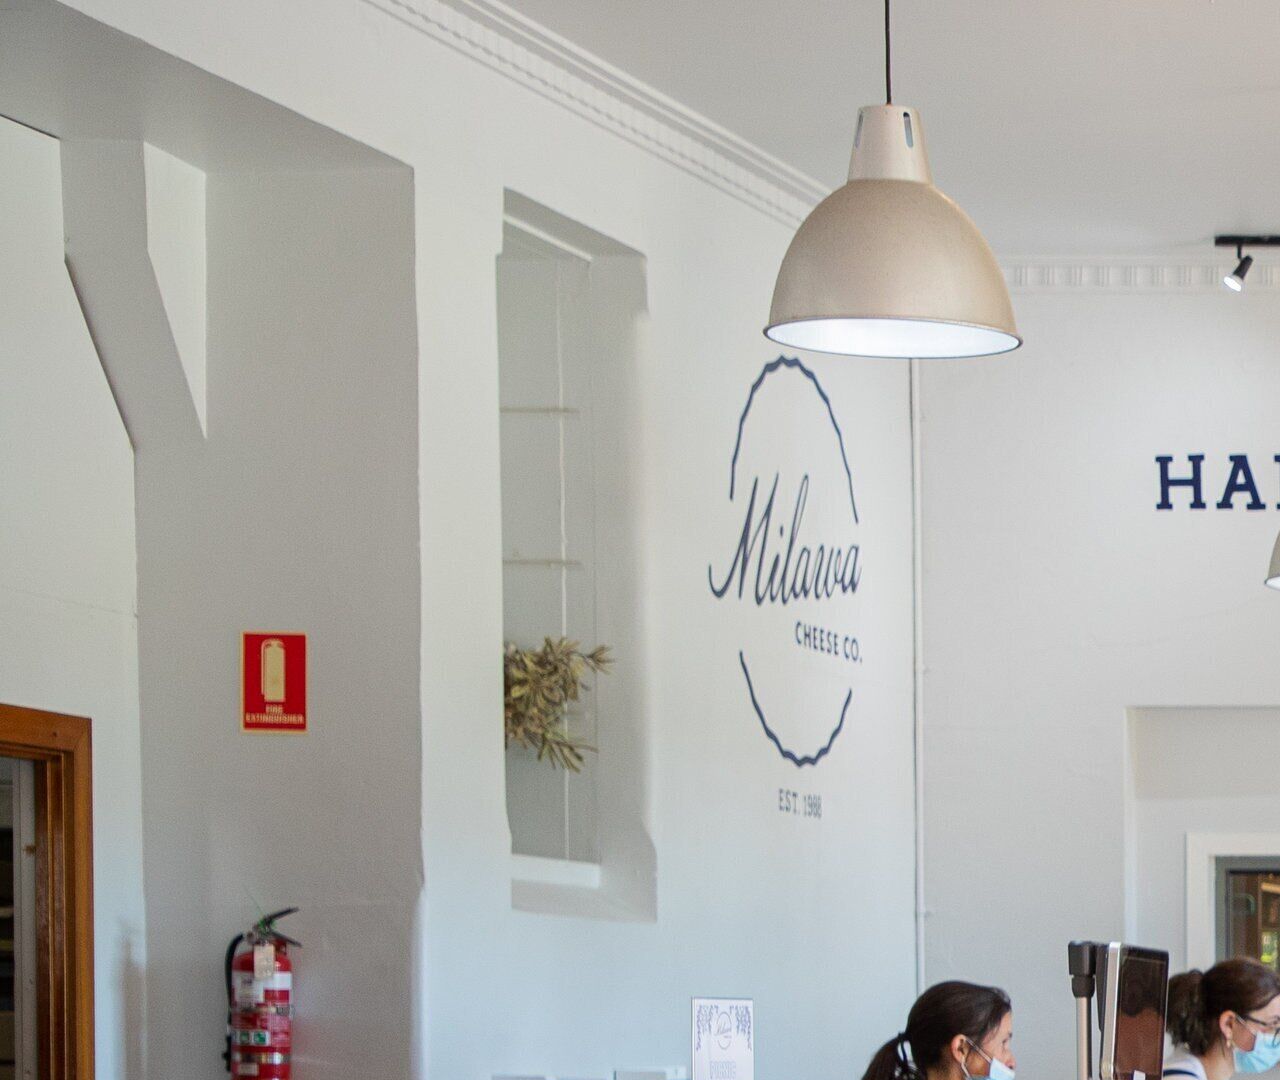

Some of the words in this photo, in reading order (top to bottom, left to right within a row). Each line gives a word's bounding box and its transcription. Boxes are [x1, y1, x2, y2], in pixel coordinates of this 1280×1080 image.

[708, 472, 861, 606] Milawa
[796, 621, 839, 655] CHEESE
[844, 636, 863, 664] CO.
[778, 788, 800, 815] EST.
